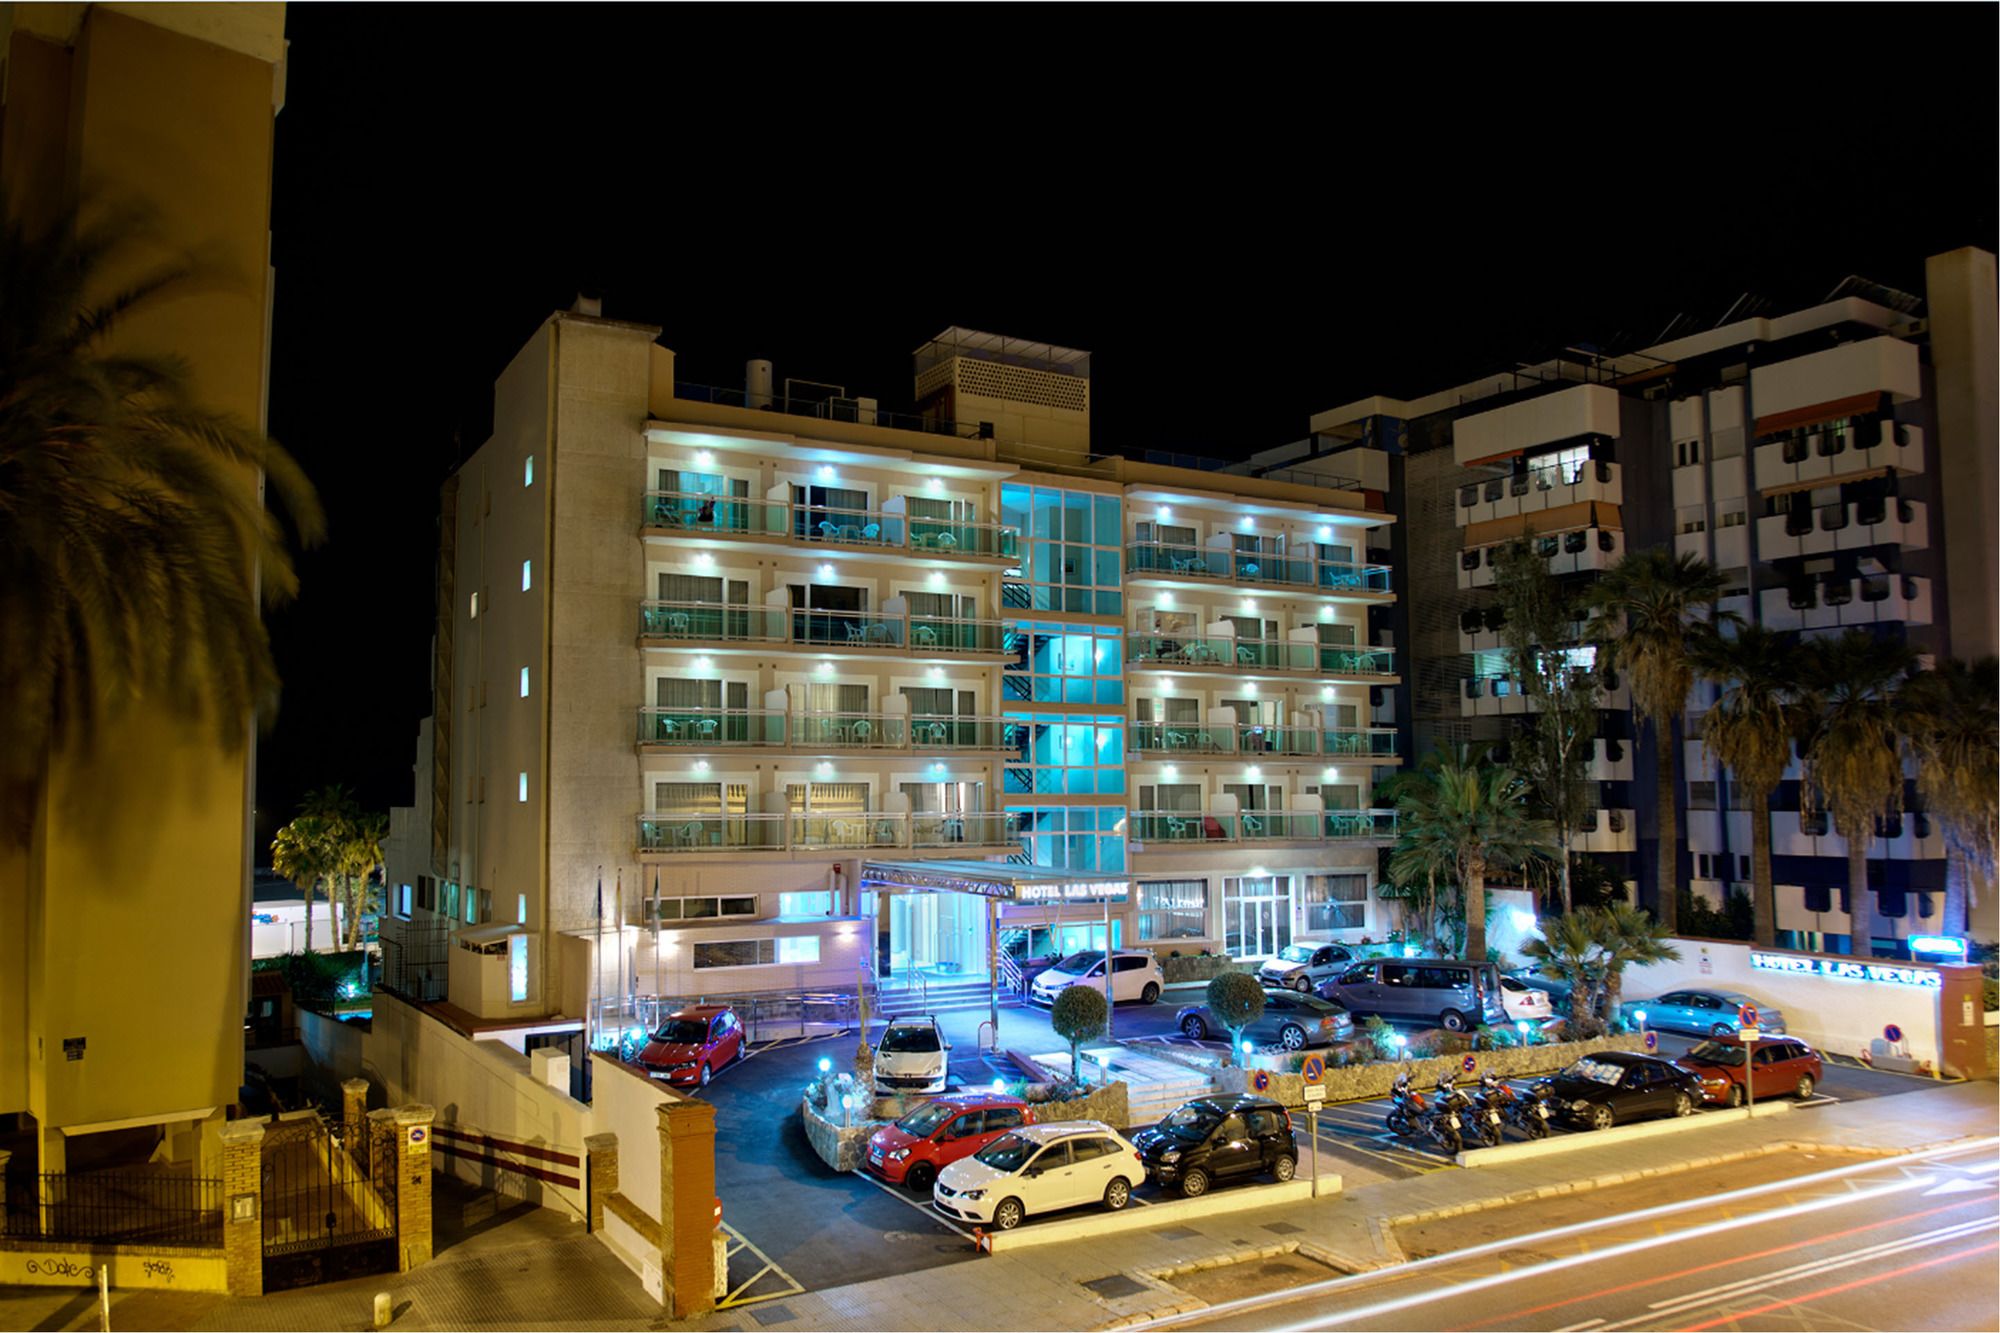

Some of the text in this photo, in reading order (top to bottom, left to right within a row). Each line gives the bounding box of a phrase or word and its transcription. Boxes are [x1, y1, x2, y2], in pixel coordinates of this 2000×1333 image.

[1022, 882, 1129, 899] HOTEL LAS VEGAS
[1751, 954, 1942, 987] HOTEL LAS VEGAS
